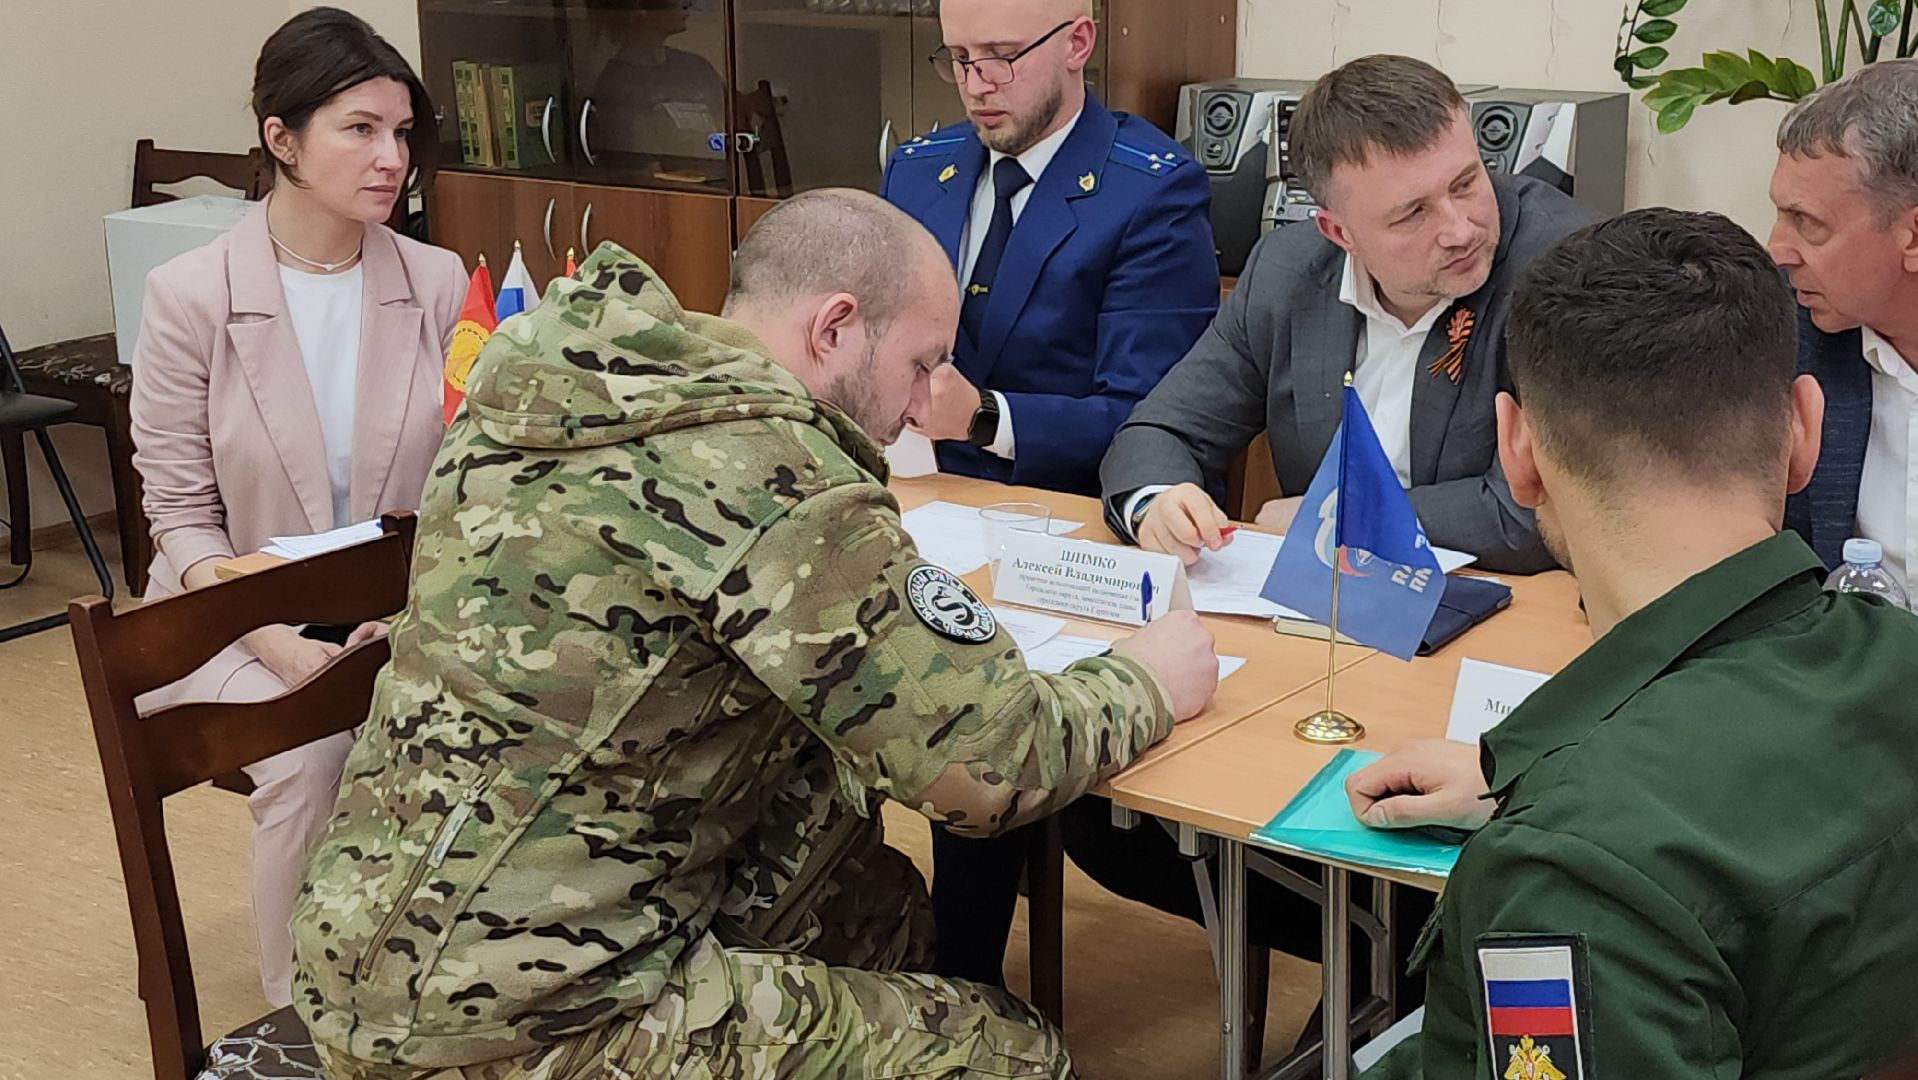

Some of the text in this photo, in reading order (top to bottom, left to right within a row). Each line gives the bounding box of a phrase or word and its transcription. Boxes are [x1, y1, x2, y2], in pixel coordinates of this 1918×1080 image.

[1060, 549, 1117, 570] ШИМКО
[1012, 557, 1063, 576] Алексей
[1065, 566, 1160, 594] Владимироч
